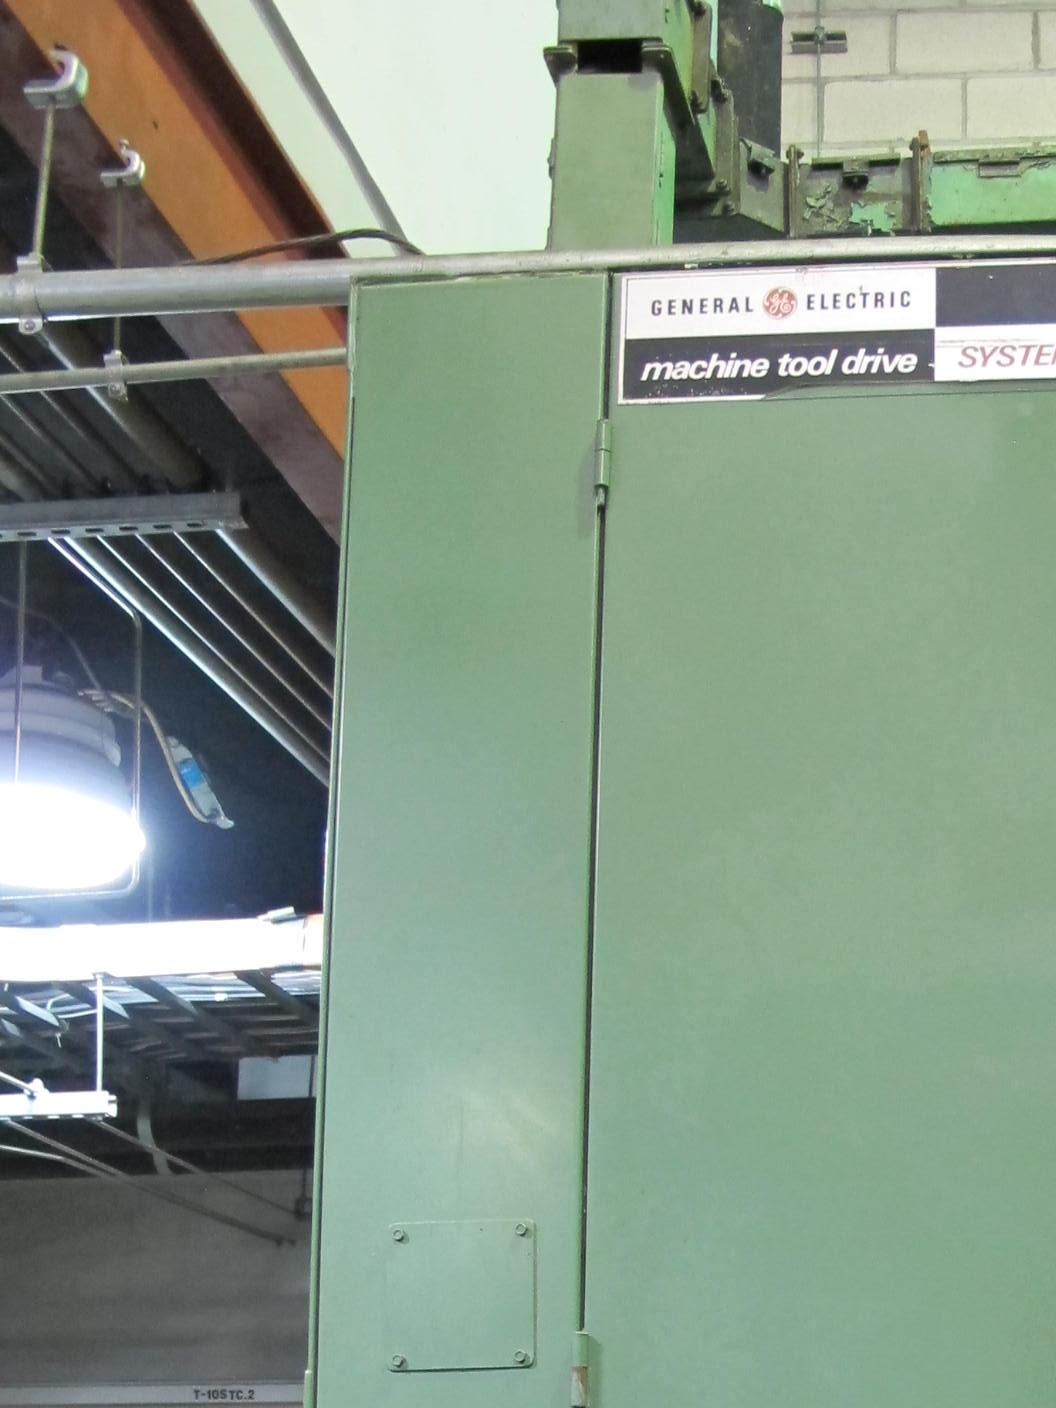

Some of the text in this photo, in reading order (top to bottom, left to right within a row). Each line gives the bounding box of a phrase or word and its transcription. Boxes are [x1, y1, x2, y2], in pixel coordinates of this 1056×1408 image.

[651, 297, 754, 317] GENERAL
[806, 290, 912, 311] ELECTRIC
[640, 348, 919, 382] machine tool drive
